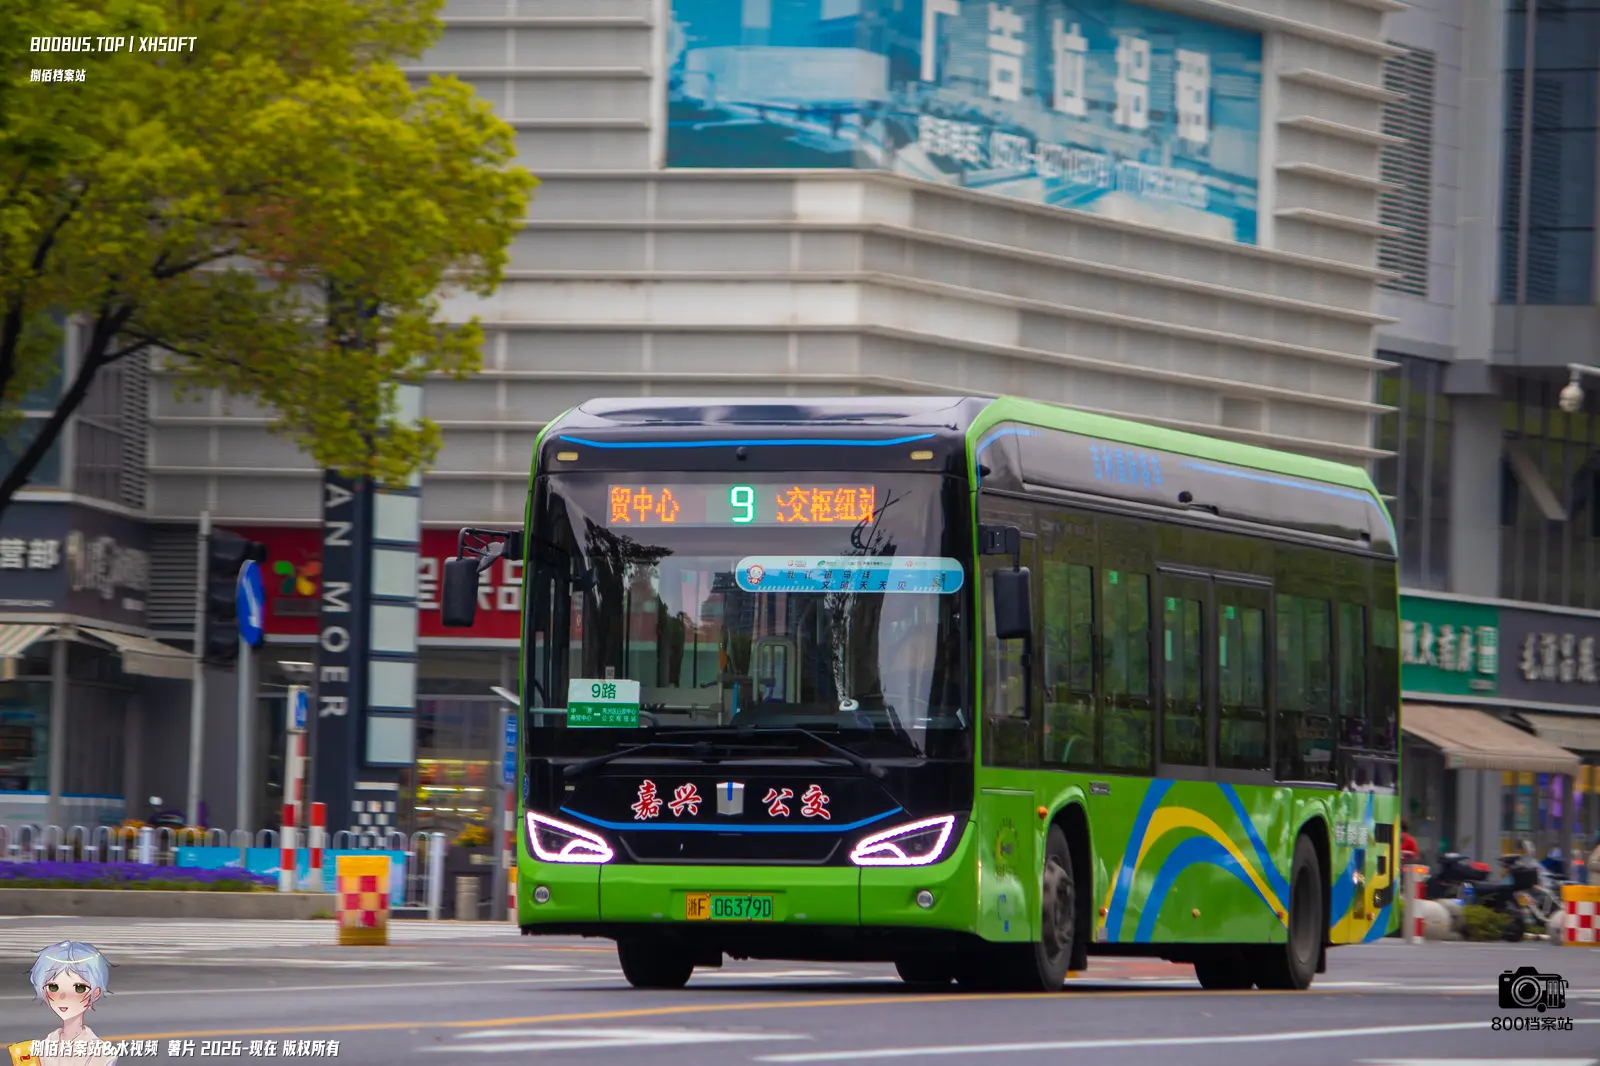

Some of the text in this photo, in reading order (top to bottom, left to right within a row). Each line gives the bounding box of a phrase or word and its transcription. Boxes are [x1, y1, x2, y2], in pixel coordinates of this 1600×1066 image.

[730, 486, 755, 523] 9
[319, 581, 352, 718] MOER
[591, 682, 617, 700] 9路
[631, 779, 831, 820] 嘉兴 公交
